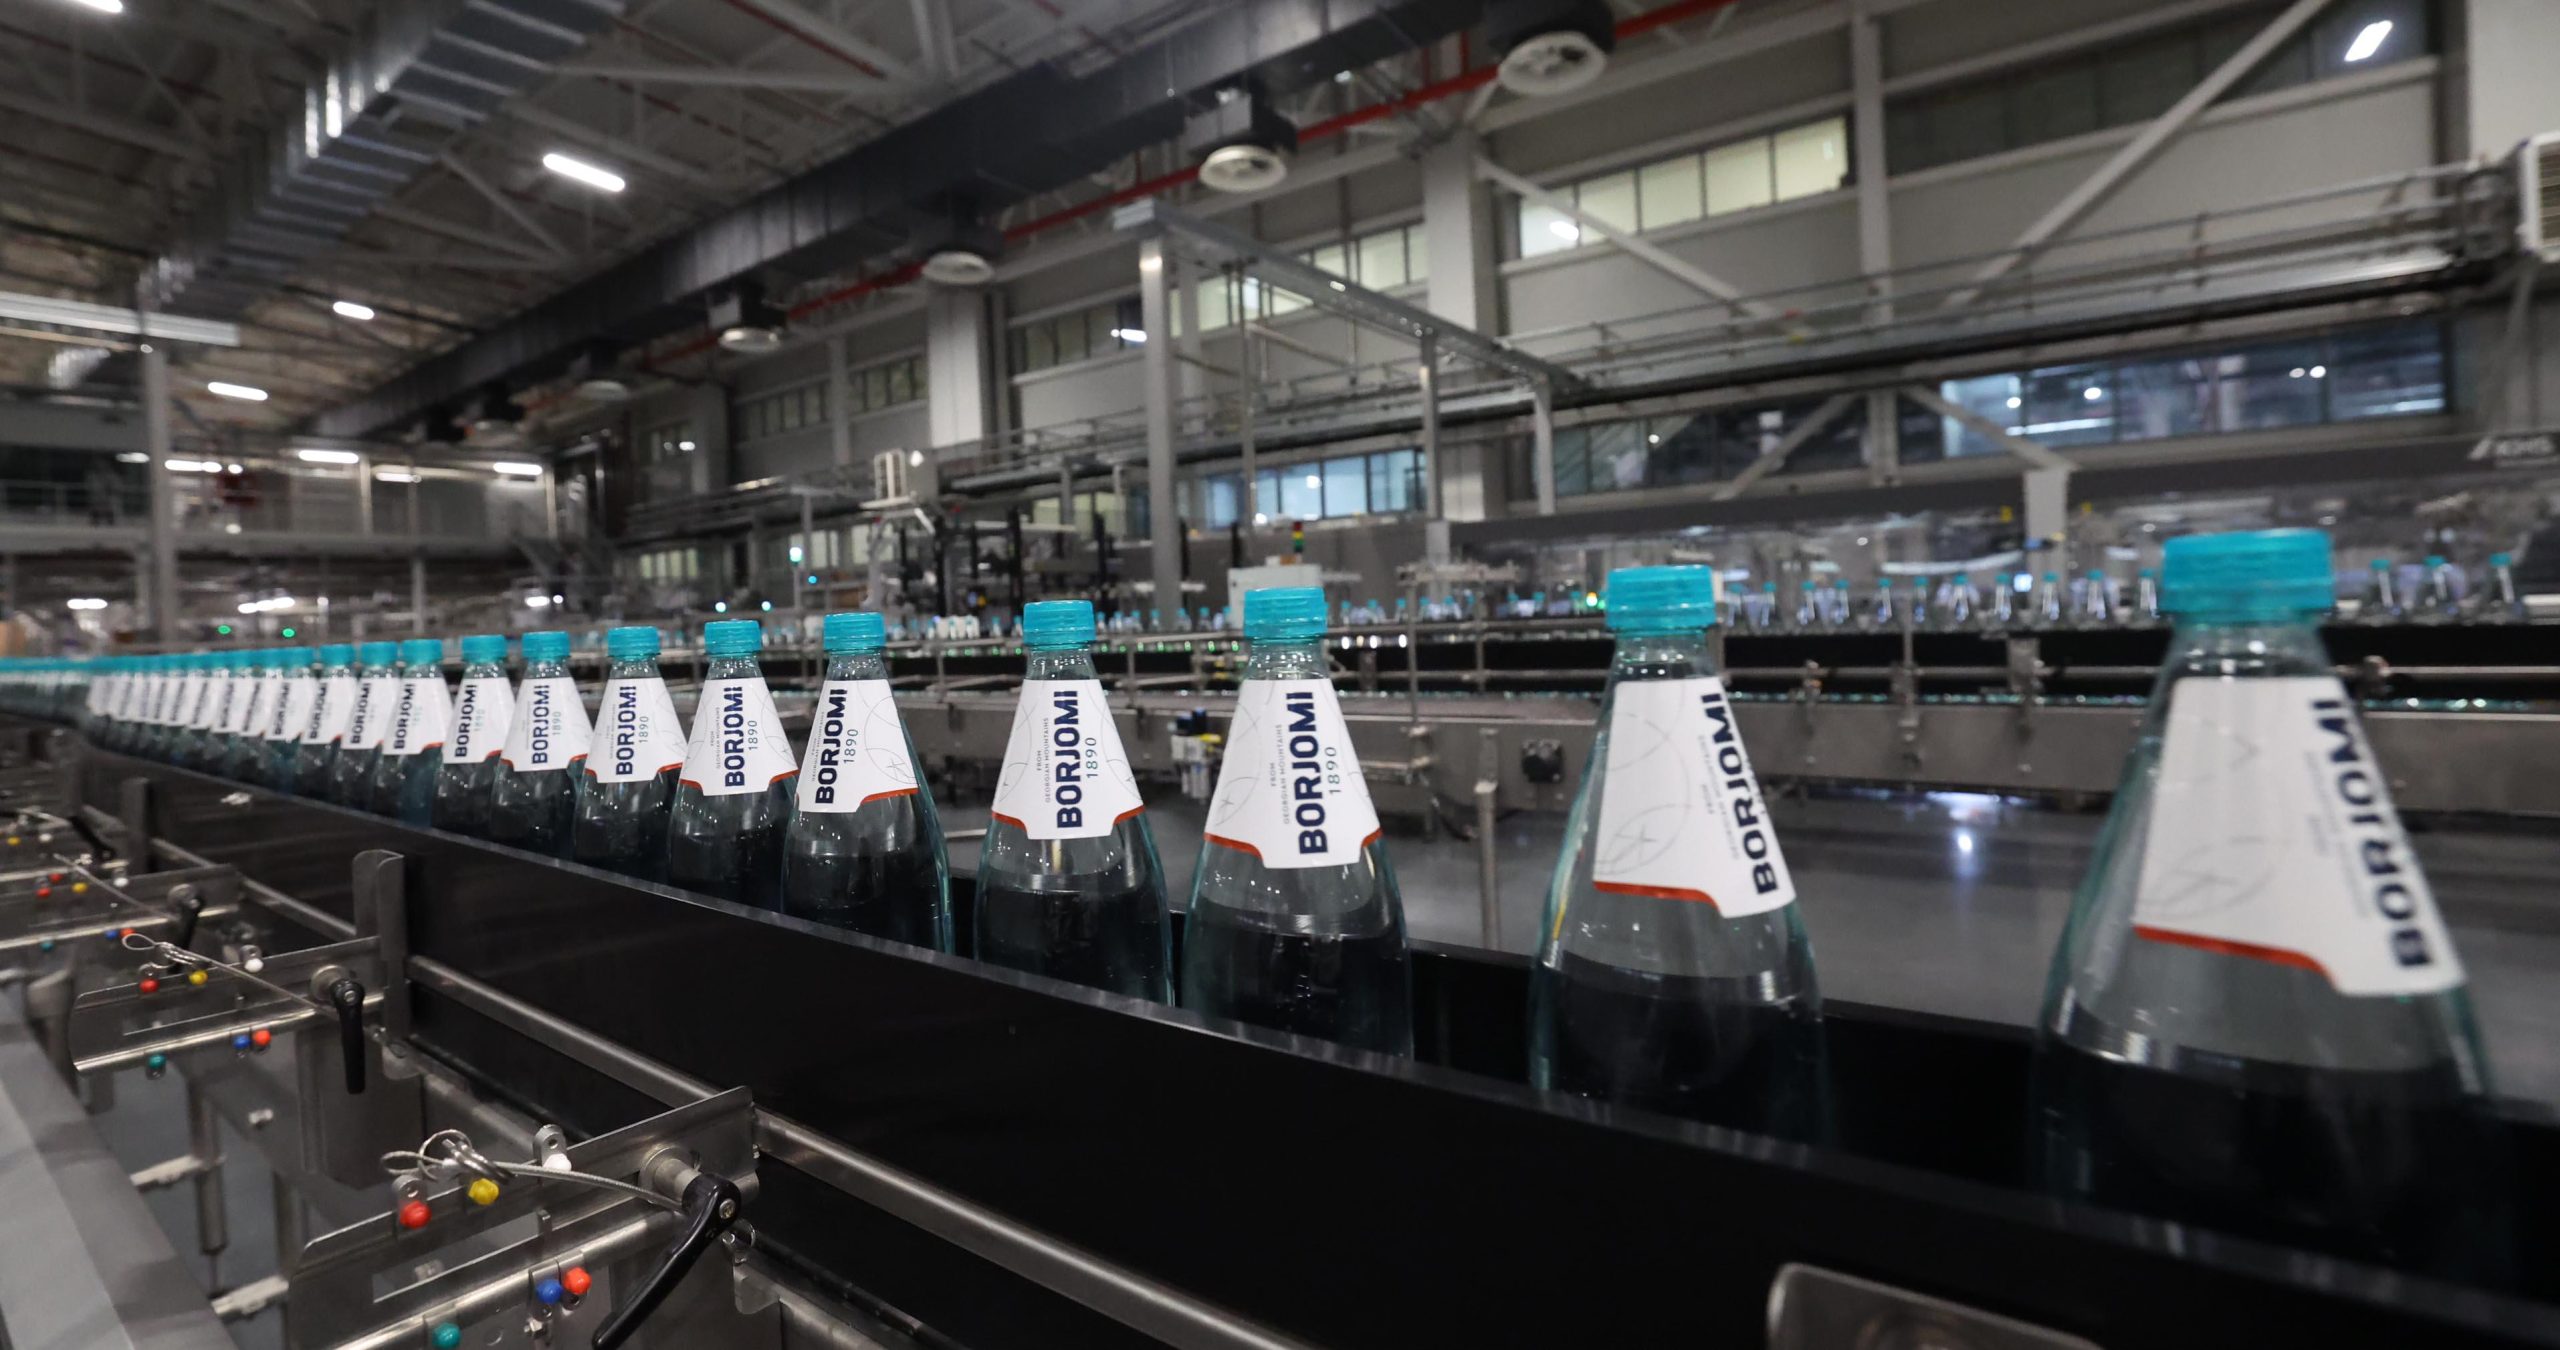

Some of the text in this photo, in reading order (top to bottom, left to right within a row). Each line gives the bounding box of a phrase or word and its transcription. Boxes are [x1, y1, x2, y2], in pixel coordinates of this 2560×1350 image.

[394, 683, 415, 749] BORJOMI
[455, 684, 477, 757] BORJOMI
[531, 685, 550, 764] BORJOMI
[552, 711, 562, 736] 1890
[615, 686, 637, 776] BORJOMI
[639, 715, 649, 744] 1890
[724, 686, 745, 787] BORJOMI
[748, 720, 758, 751] 1890
[815, 688, 848, 804] BORJOMI
[843, 728, 859, 765] 1890
[1053, 691, 1082, 828] BORJOMI
[1085, 737, 1098, 779] 1890
[1275, 724, 1290, 825] GEORGIAN MOUNTAINS
[1286, 691, 1328, 854] BORJOMI
[1324, 747, 1342, 795] 1890
[1701, 693, 1778, 895] BORJOMI
[2312, 700, 2432, 966] BORJOMI
